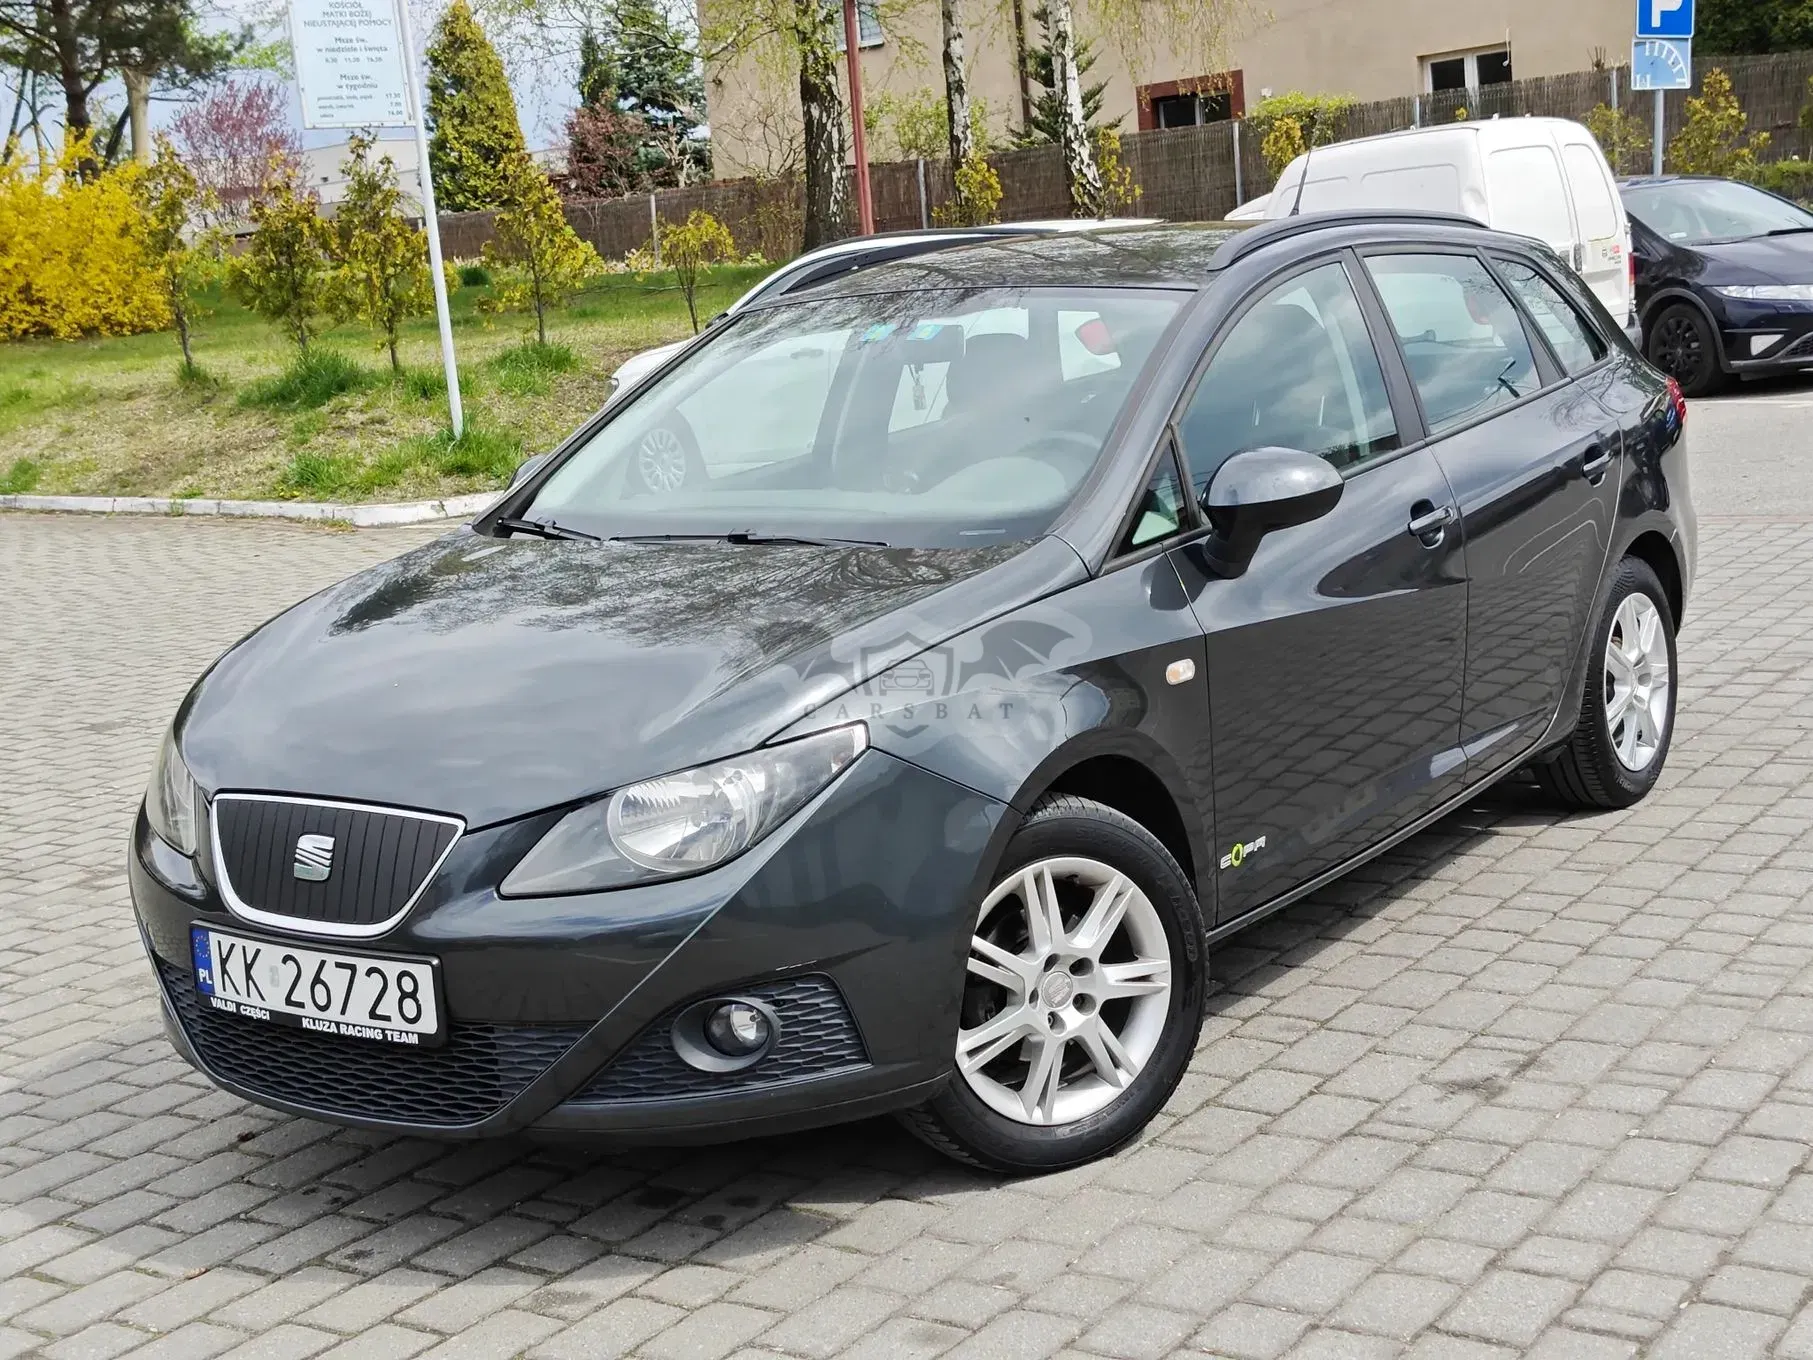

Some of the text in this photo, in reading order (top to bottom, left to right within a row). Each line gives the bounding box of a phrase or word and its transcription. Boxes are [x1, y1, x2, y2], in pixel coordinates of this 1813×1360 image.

[349, 9, 372, 19] BOŻEJ
[303, 20, 357, 28] NIEUSTAJĄCEJ
[198, 967, 213, 985] PL
[217, 940, 422, 1025] KK 26728
[210, 996, 419, 1045] VALDI CZĘŚCI KLUZA RACING TEAM
